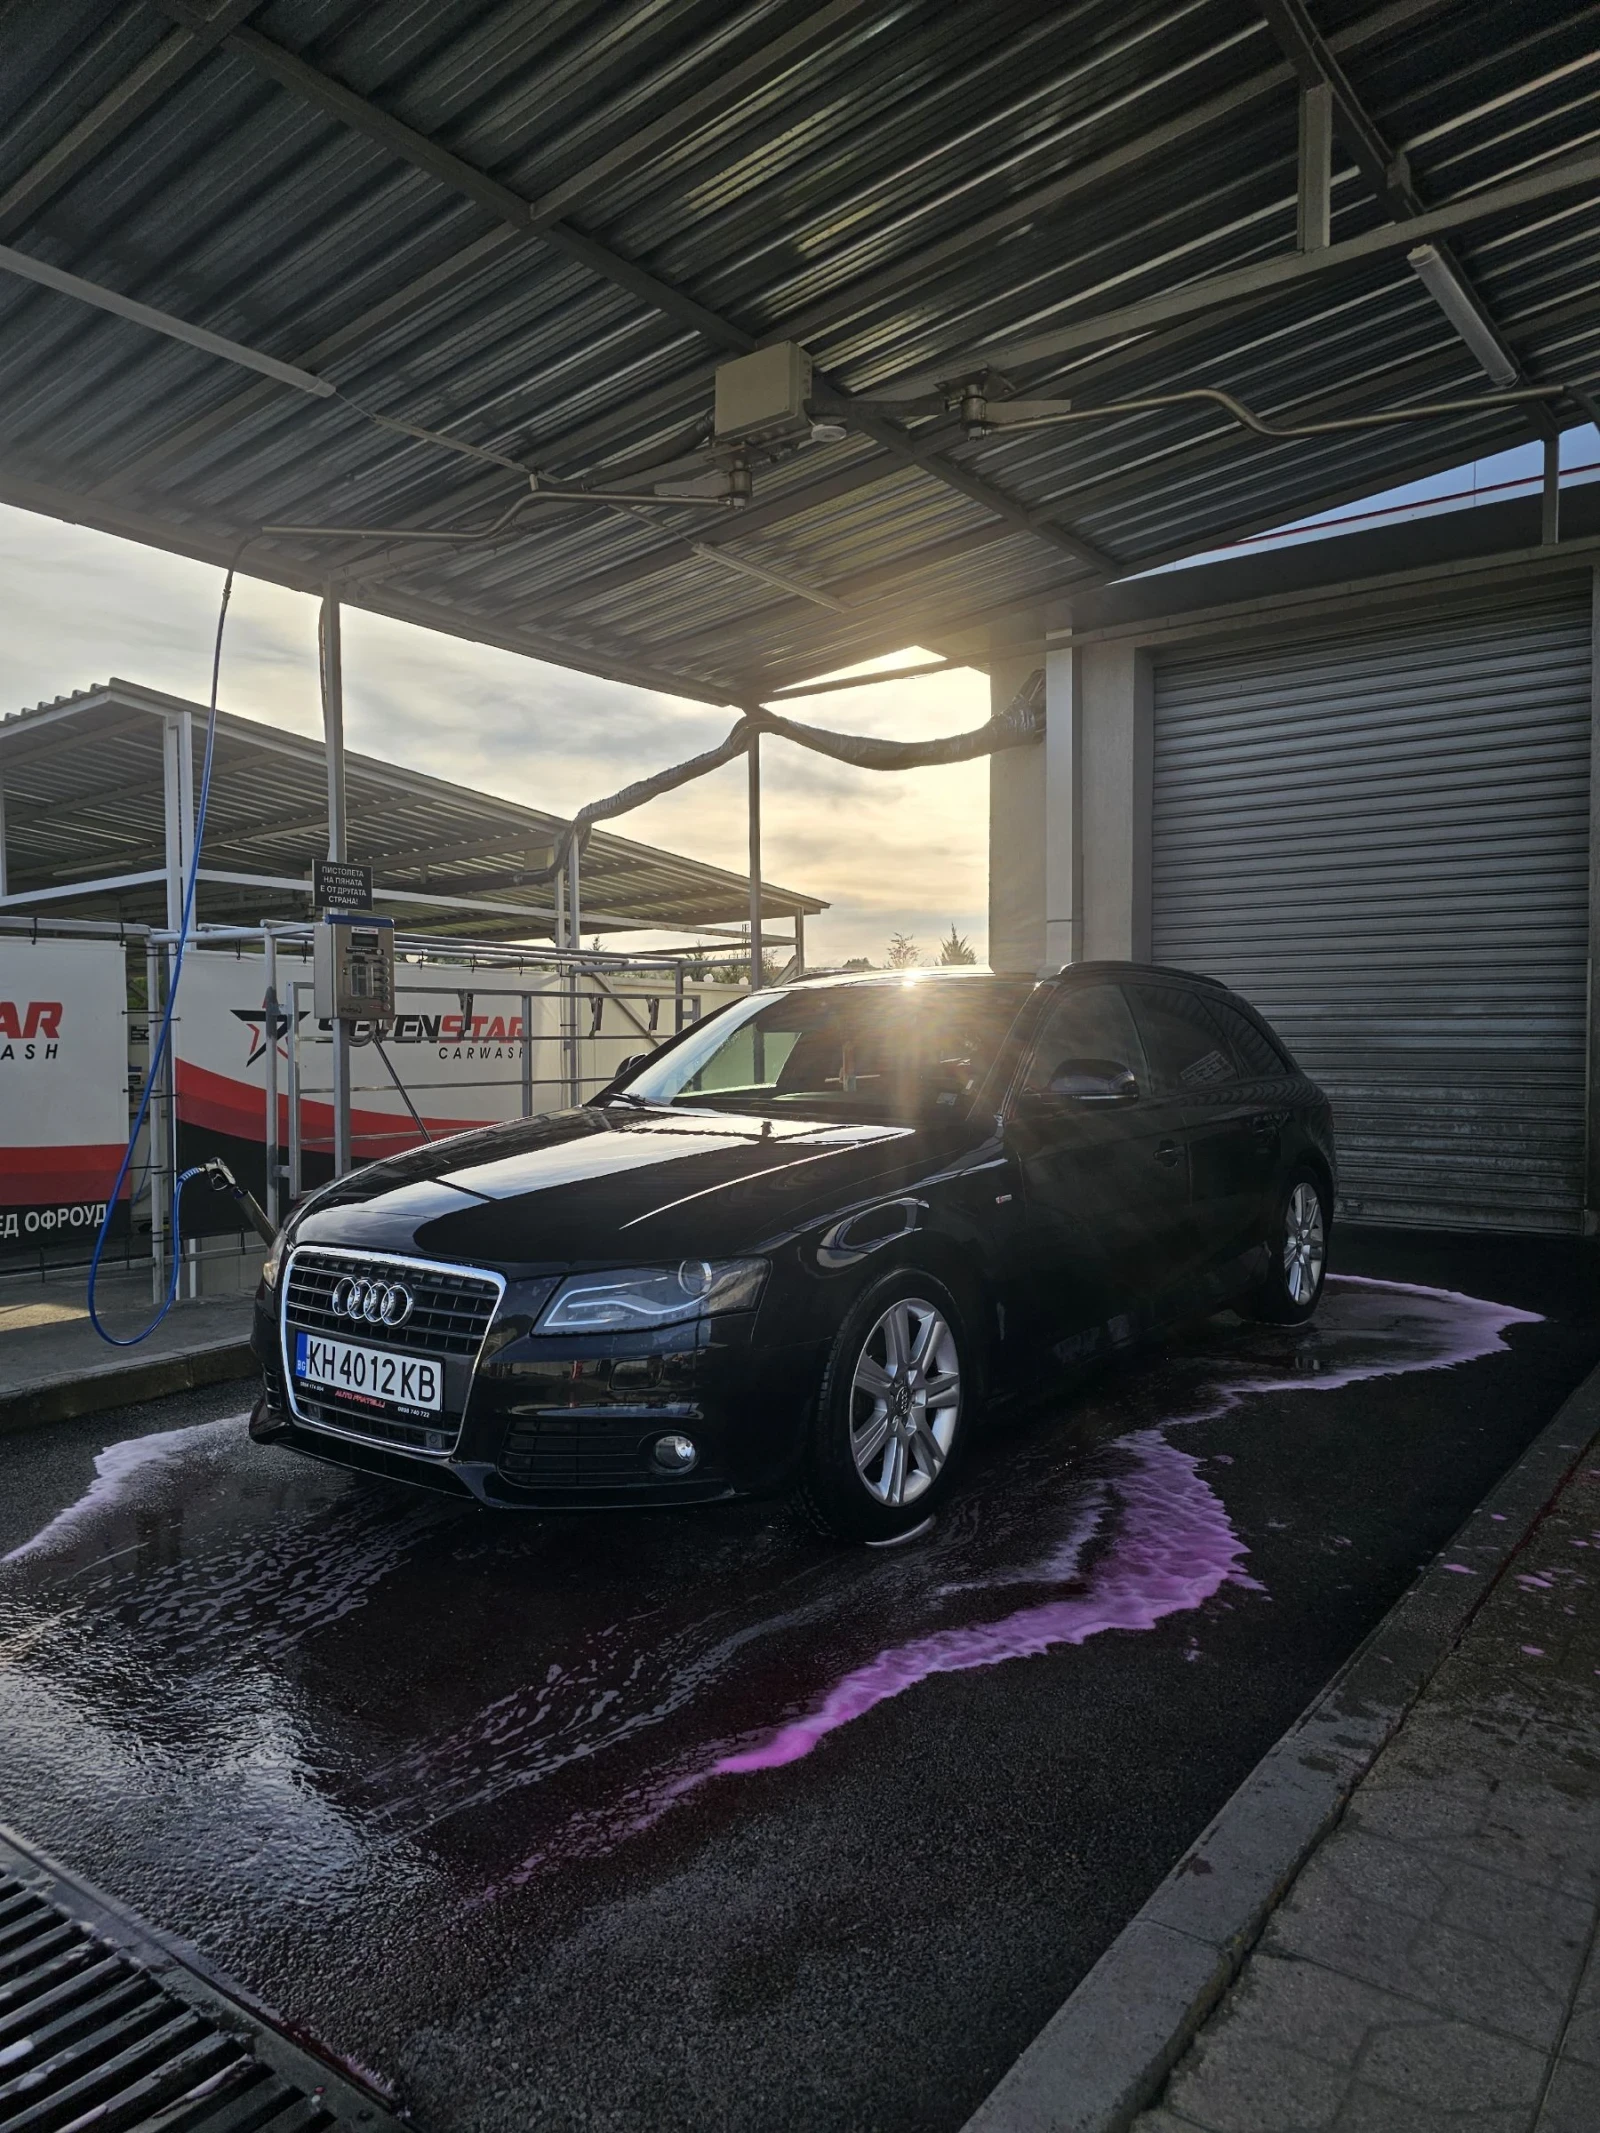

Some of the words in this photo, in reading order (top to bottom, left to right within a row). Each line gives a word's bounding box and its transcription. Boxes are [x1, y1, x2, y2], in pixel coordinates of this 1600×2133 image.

[322, 866, 364, 877] ПИСТОЛЕТА
[335, 877, 363, 887] ПЯНАТА
[326, 885, 336, 893] ОТ
[337, 887, 367, 896] ДРУГАТА
[328, 895, 359, 905] СТРАНА!
[24, 1204, 107, 1232] ОФРОУД
[297, 1359, 306, 1371] BG
